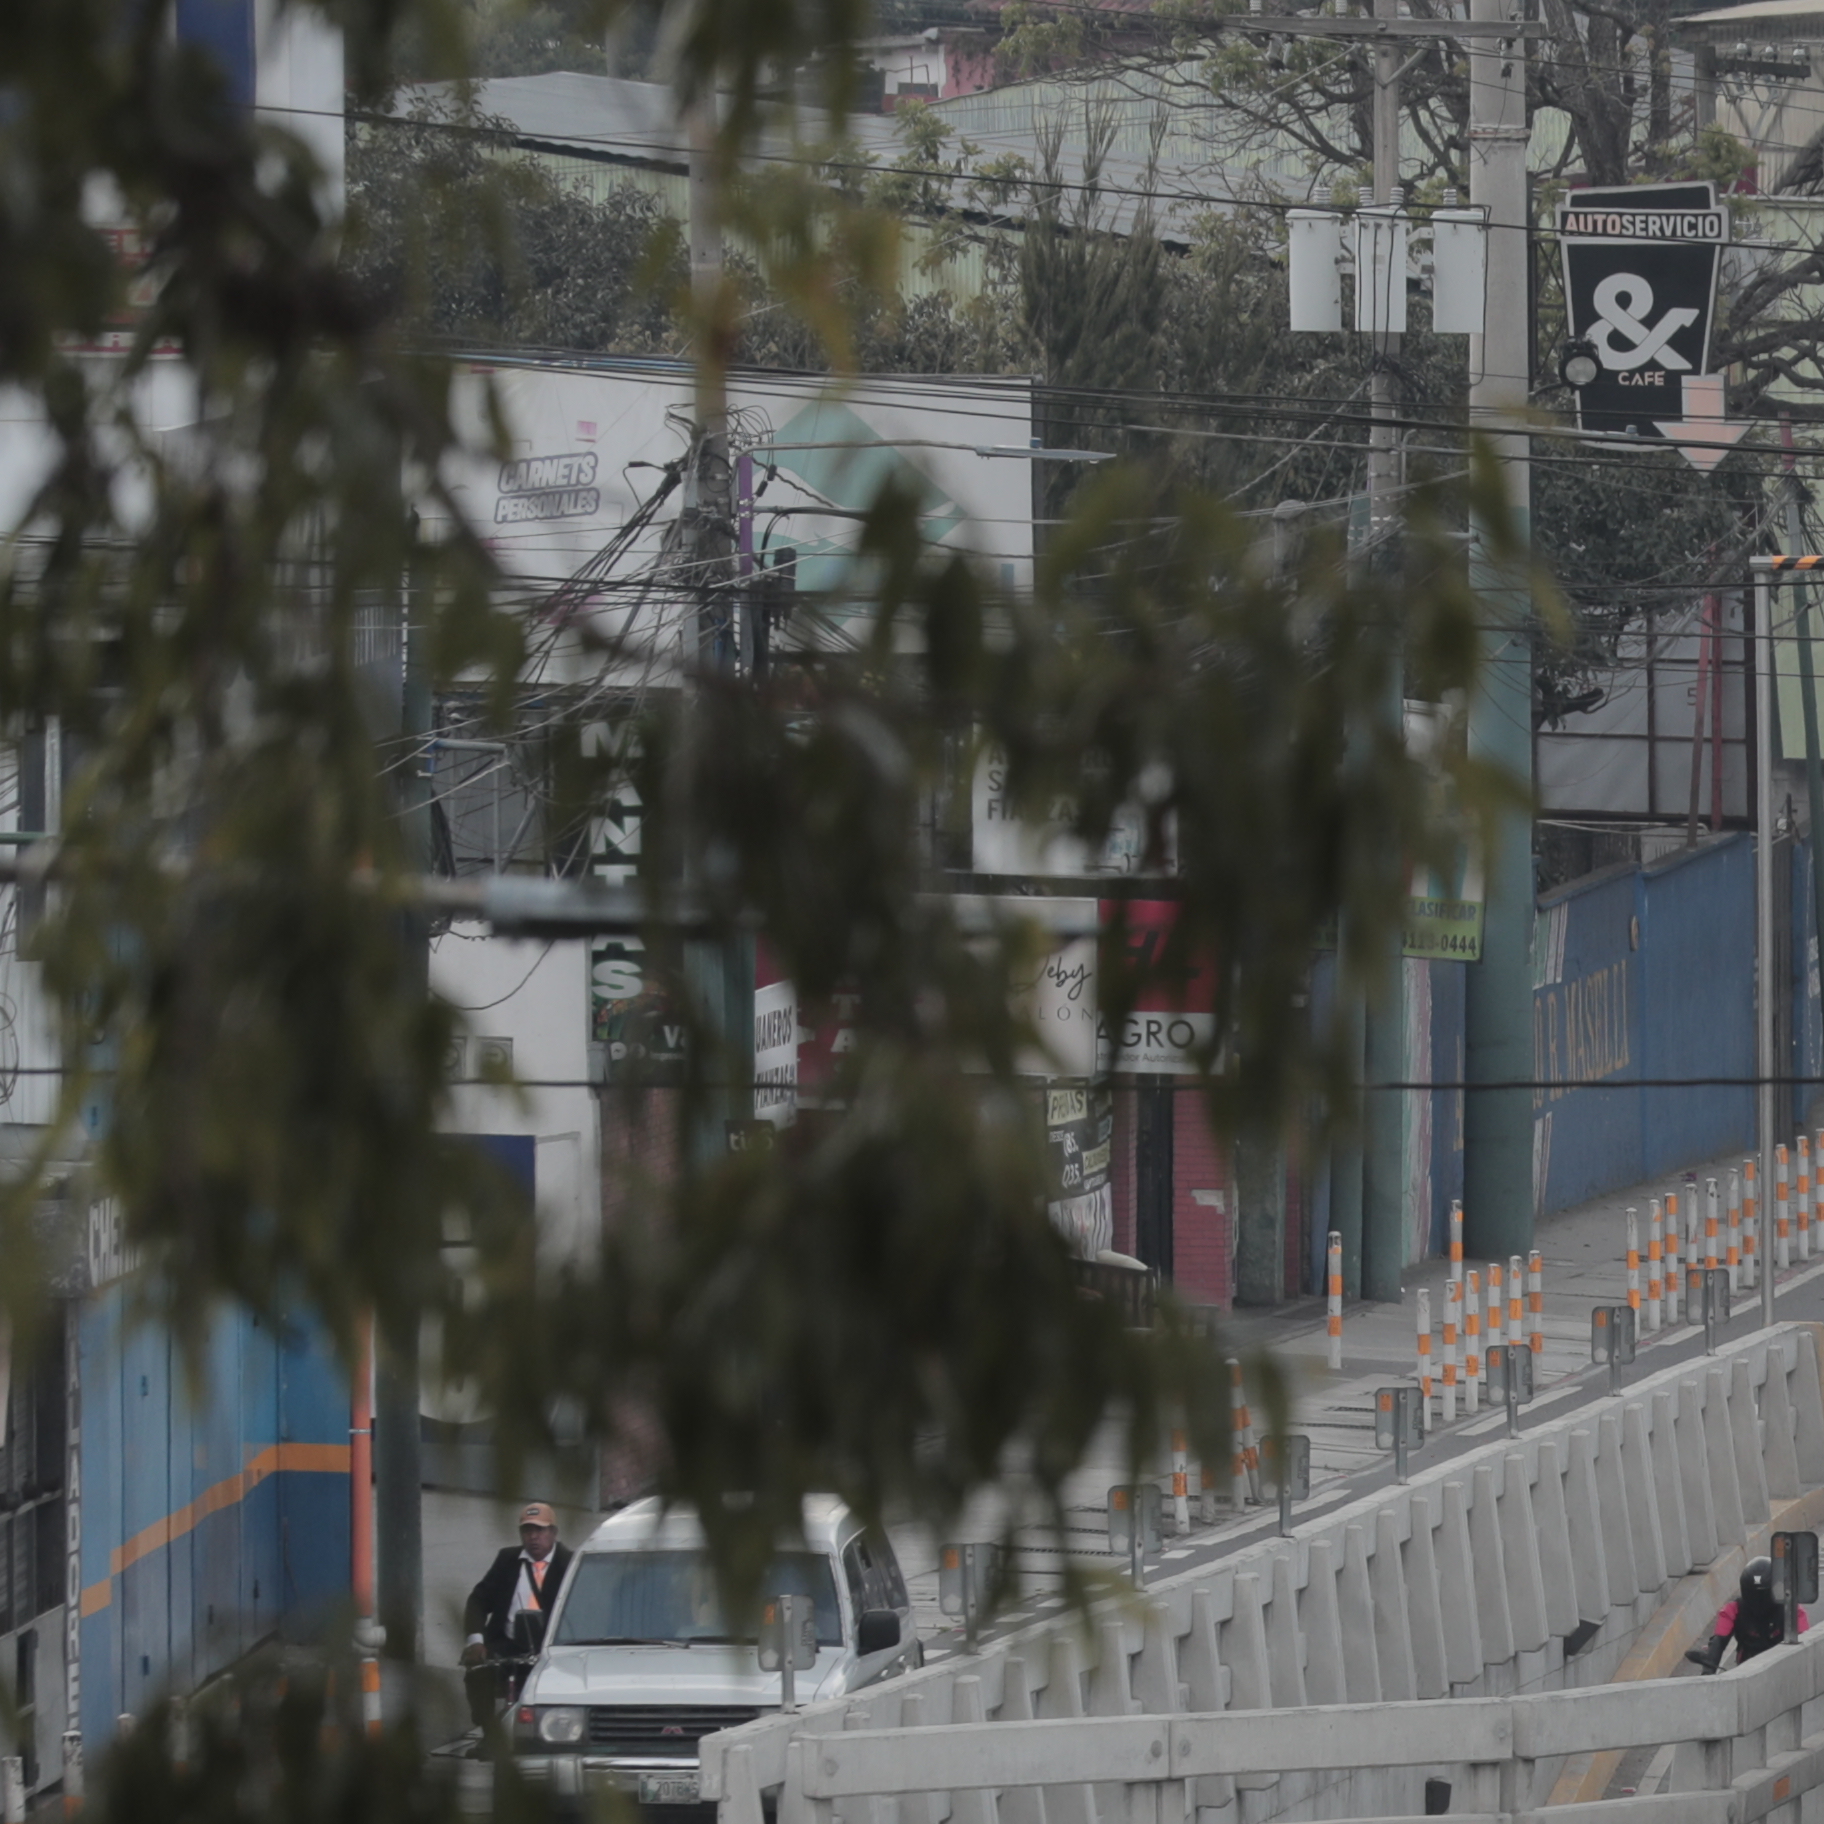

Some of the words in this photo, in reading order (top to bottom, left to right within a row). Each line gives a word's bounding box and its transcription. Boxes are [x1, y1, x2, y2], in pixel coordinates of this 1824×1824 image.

[1565, 213, 1719, 238] AUTOSERVICIO
[1587, 272, 1700, 371] &
[502, 455, 595, 491] CARNETS
[496, 490, 598, 520] PERSONALES
[988, 802, 1081, 822] FIAZA
